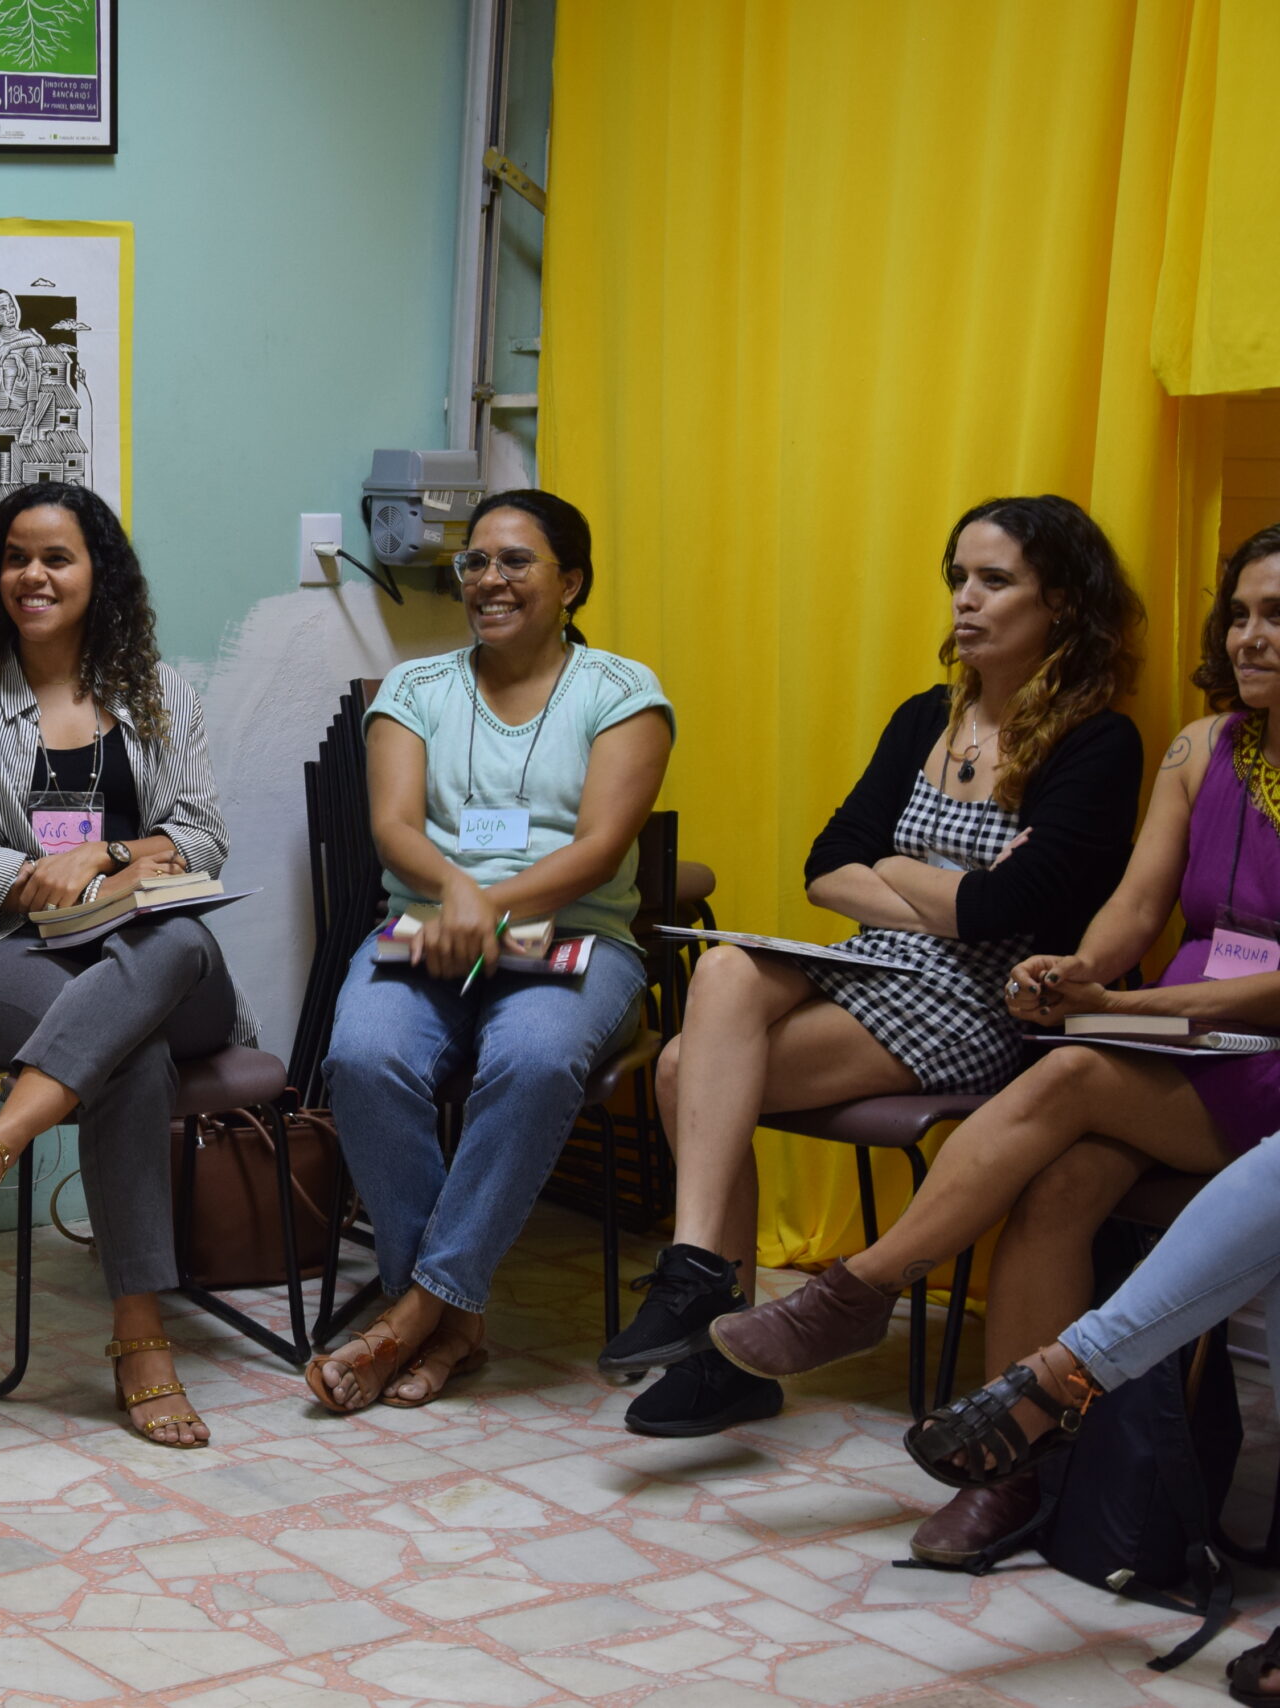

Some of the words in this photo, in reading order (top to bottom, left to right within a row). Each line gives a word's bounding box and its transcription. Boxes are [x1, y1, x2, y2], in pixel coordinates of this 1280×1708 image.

[44, 80, 78, 90] SINDICATO
[80, 82, 93, 90] DOS
[8, 85, 41, 104] 18h30
[52, 89, 90, 100] BANCÁRIOS
[1213, 941, 1269, 963] KARUNA
